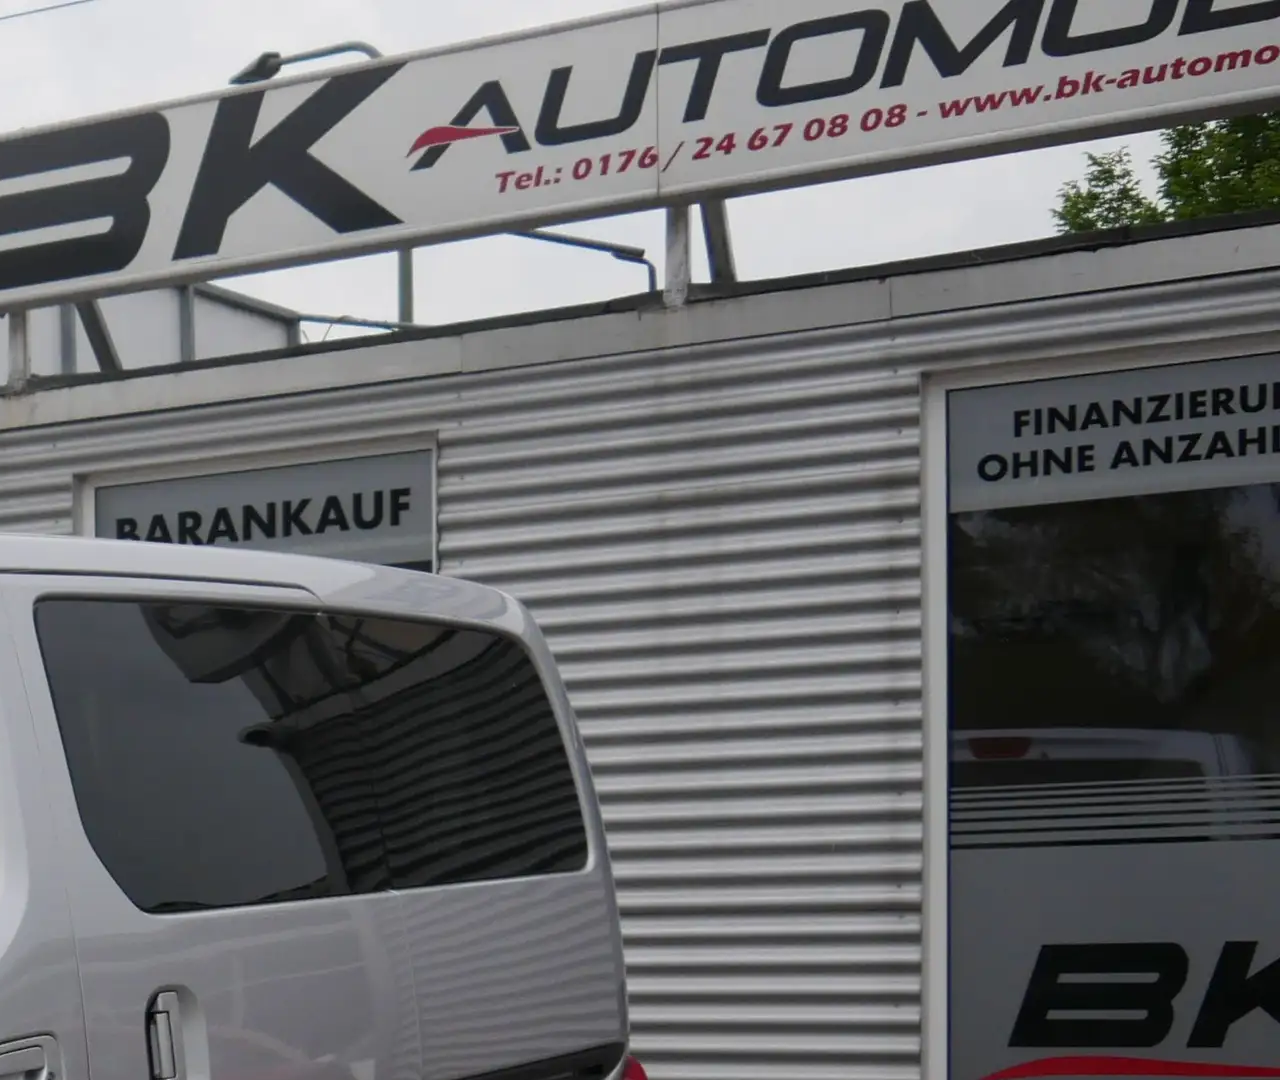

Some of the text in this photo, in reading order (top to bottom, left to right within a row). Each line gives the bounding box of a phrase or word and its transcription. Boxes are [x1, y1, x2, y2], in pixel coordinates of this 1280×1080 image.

[495, 165, 562, 193] Tel.:
[572, 145, 658, 180] 0176
[692, 136, 736, 160] 24
[747, 123, 792, 151] 67
[803, 113, 849, 141] 08
[860, 104, 907, 132] 08
[977, 444, 1095, 482] OHNE
[116, 487, 412, 546] BARANKAUF
